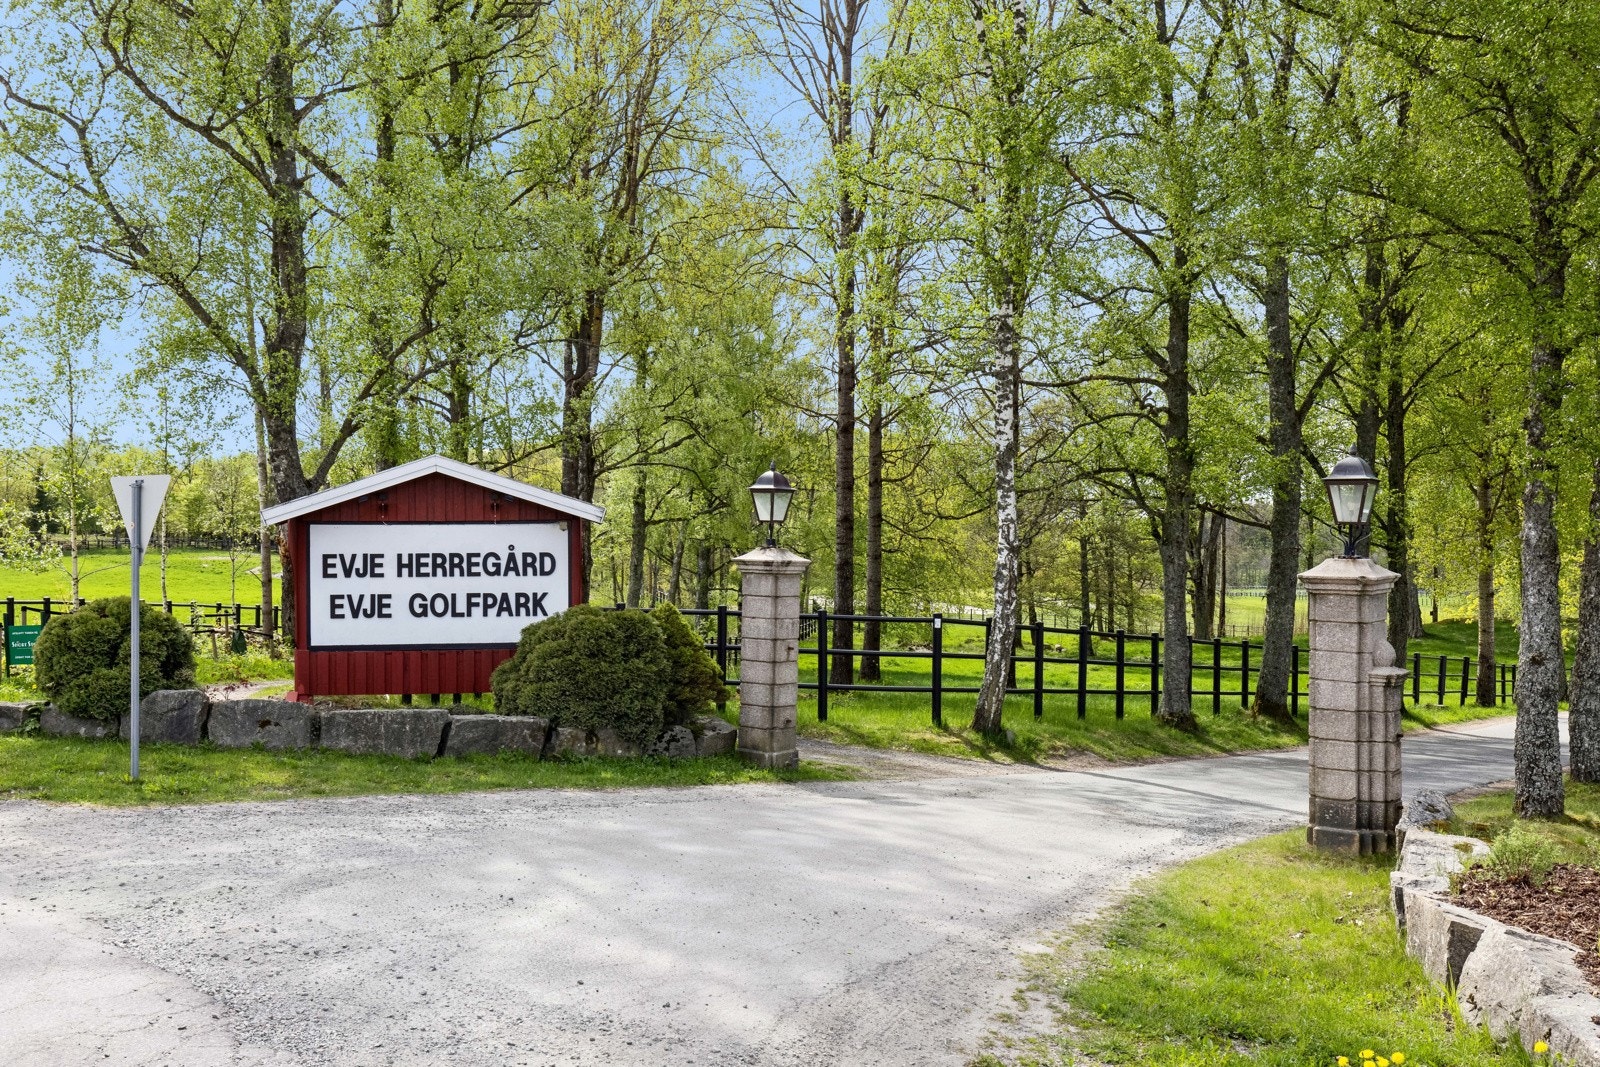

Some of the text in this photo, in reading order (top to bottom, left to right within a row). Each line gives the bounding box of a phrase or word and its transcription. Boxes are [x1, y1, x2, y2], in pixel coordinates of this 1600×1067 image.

[322, 544, 557, 578] EVJE HERREGÅRD
[329, 592, 549, 619] EVJE GOLFPARK
